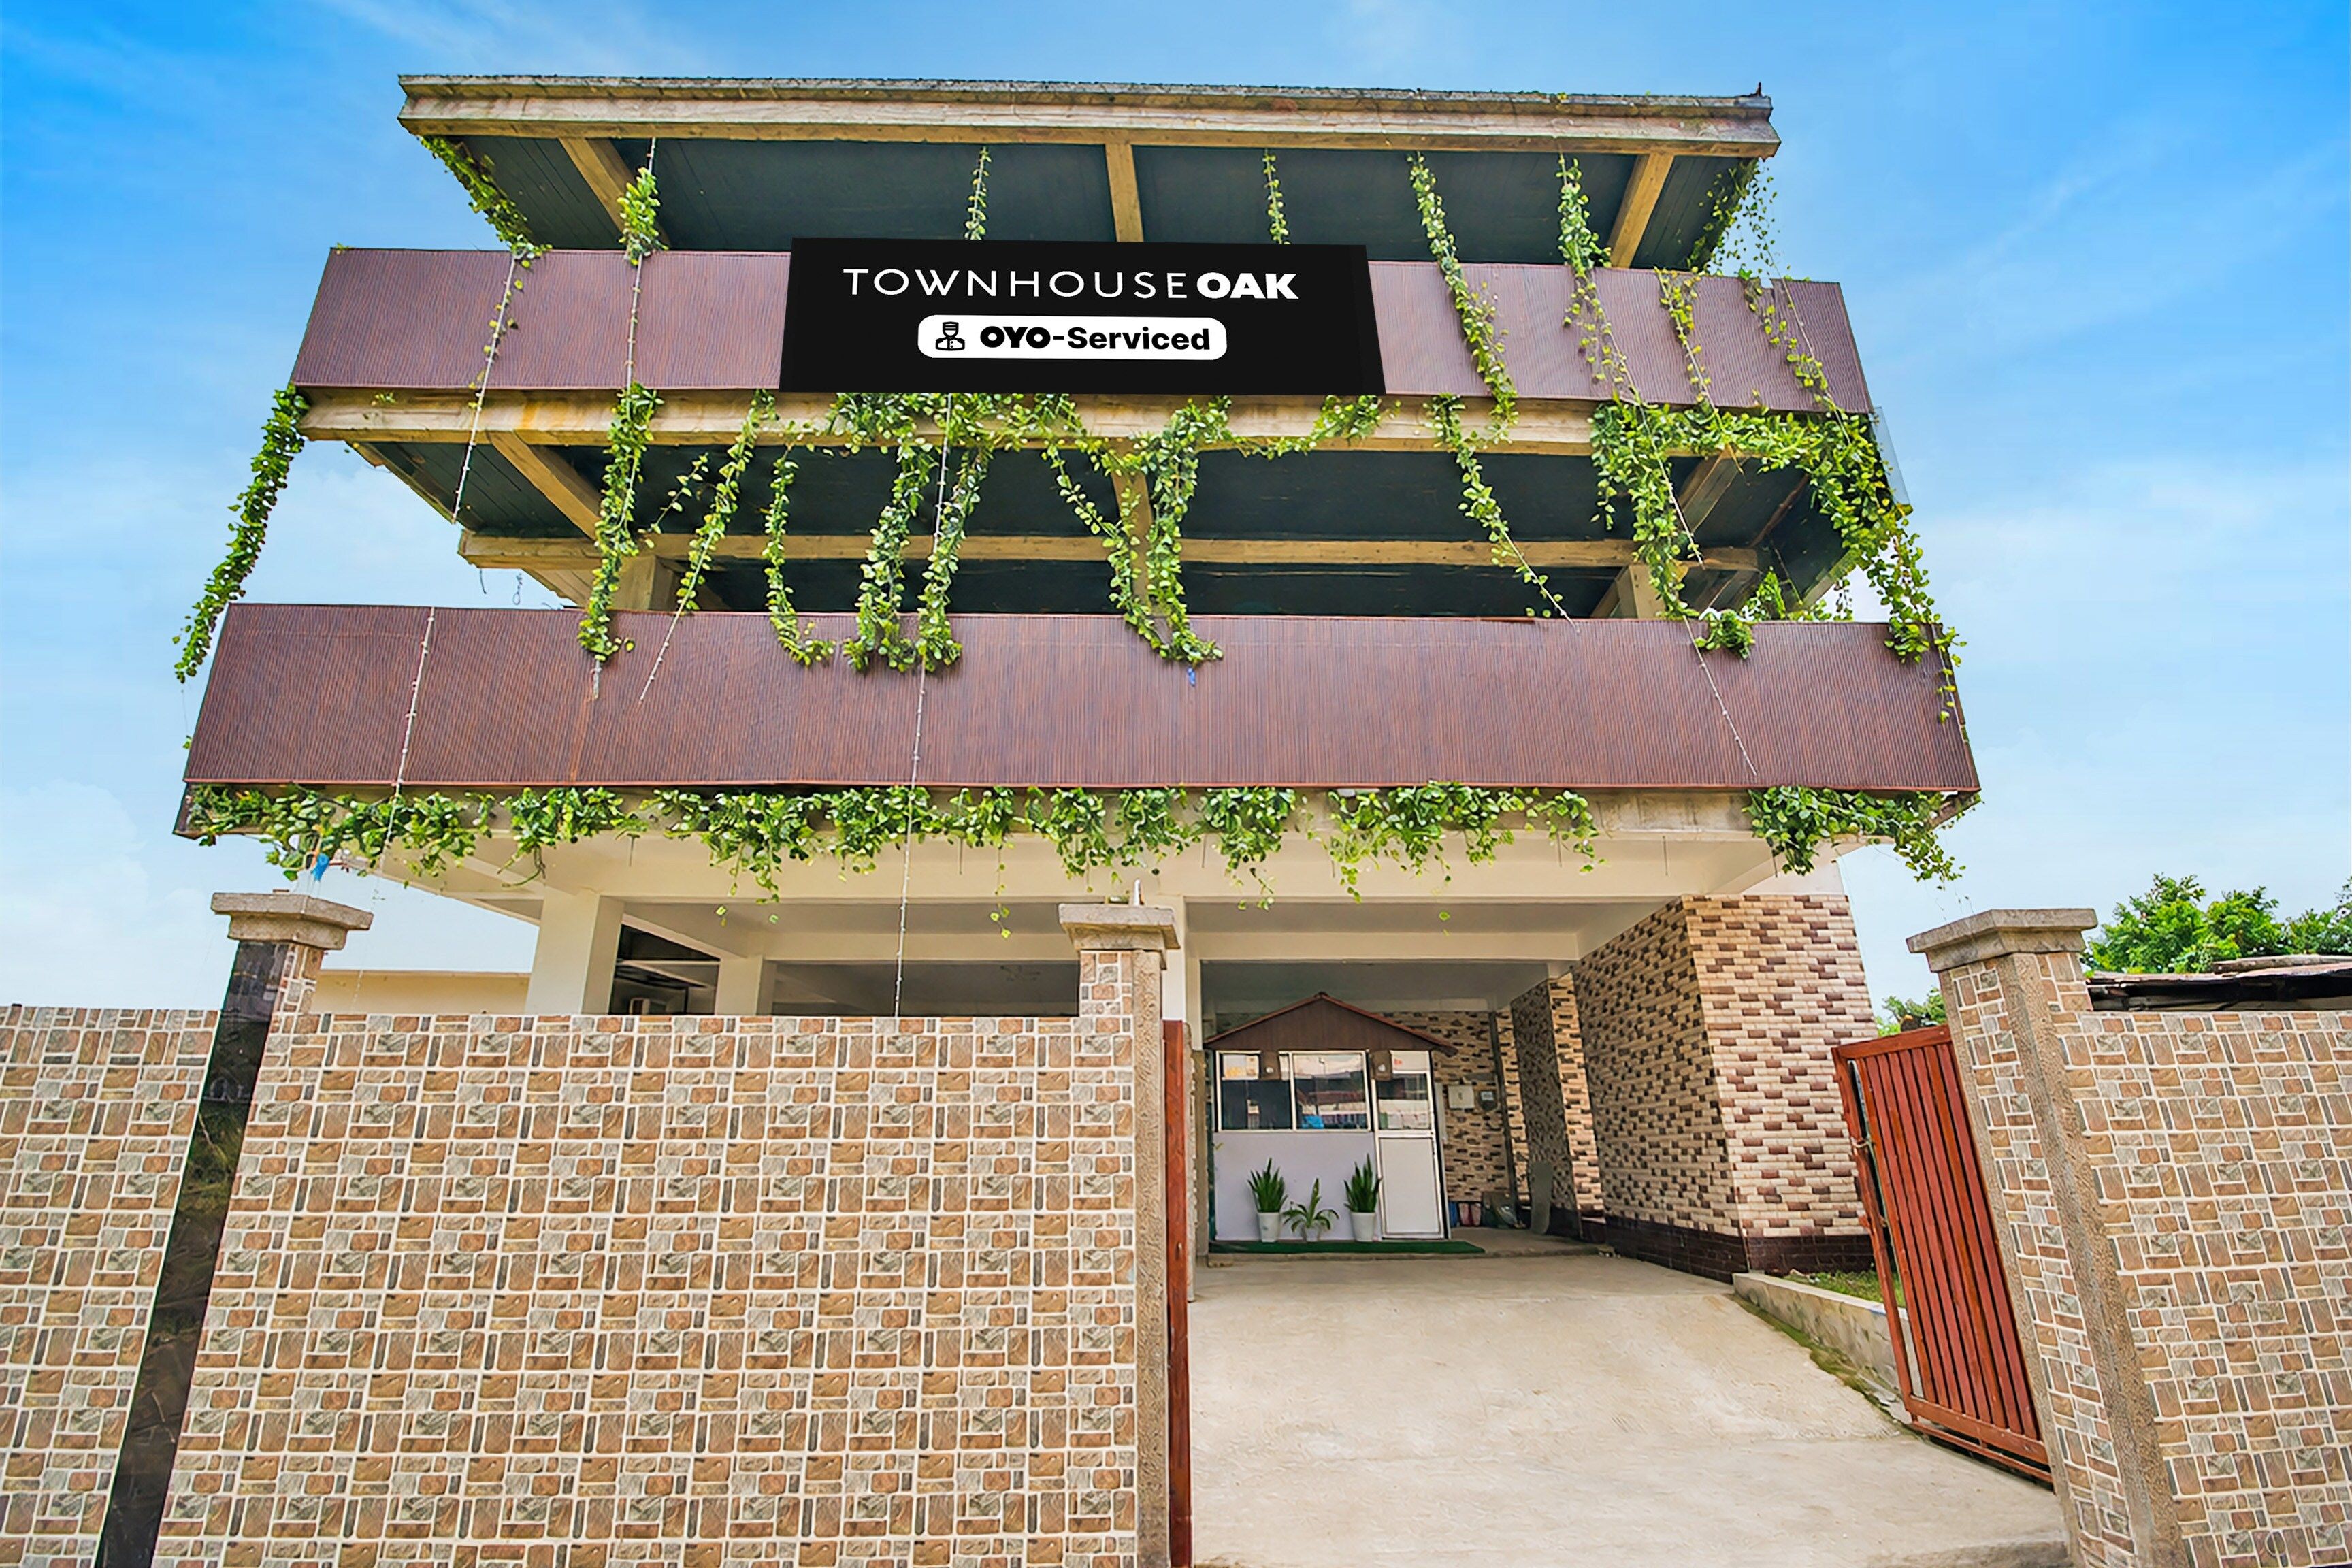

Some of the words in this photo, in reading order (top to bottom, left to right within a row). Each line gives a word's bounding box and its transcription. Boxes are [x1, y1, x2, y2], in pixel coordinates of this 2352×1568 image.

[843, 268, 1188, 299] TOWNHOUSE
[1196, 272, 1299, 300] OAK
[980, 325, 1210, 350] OYO-Serviced
